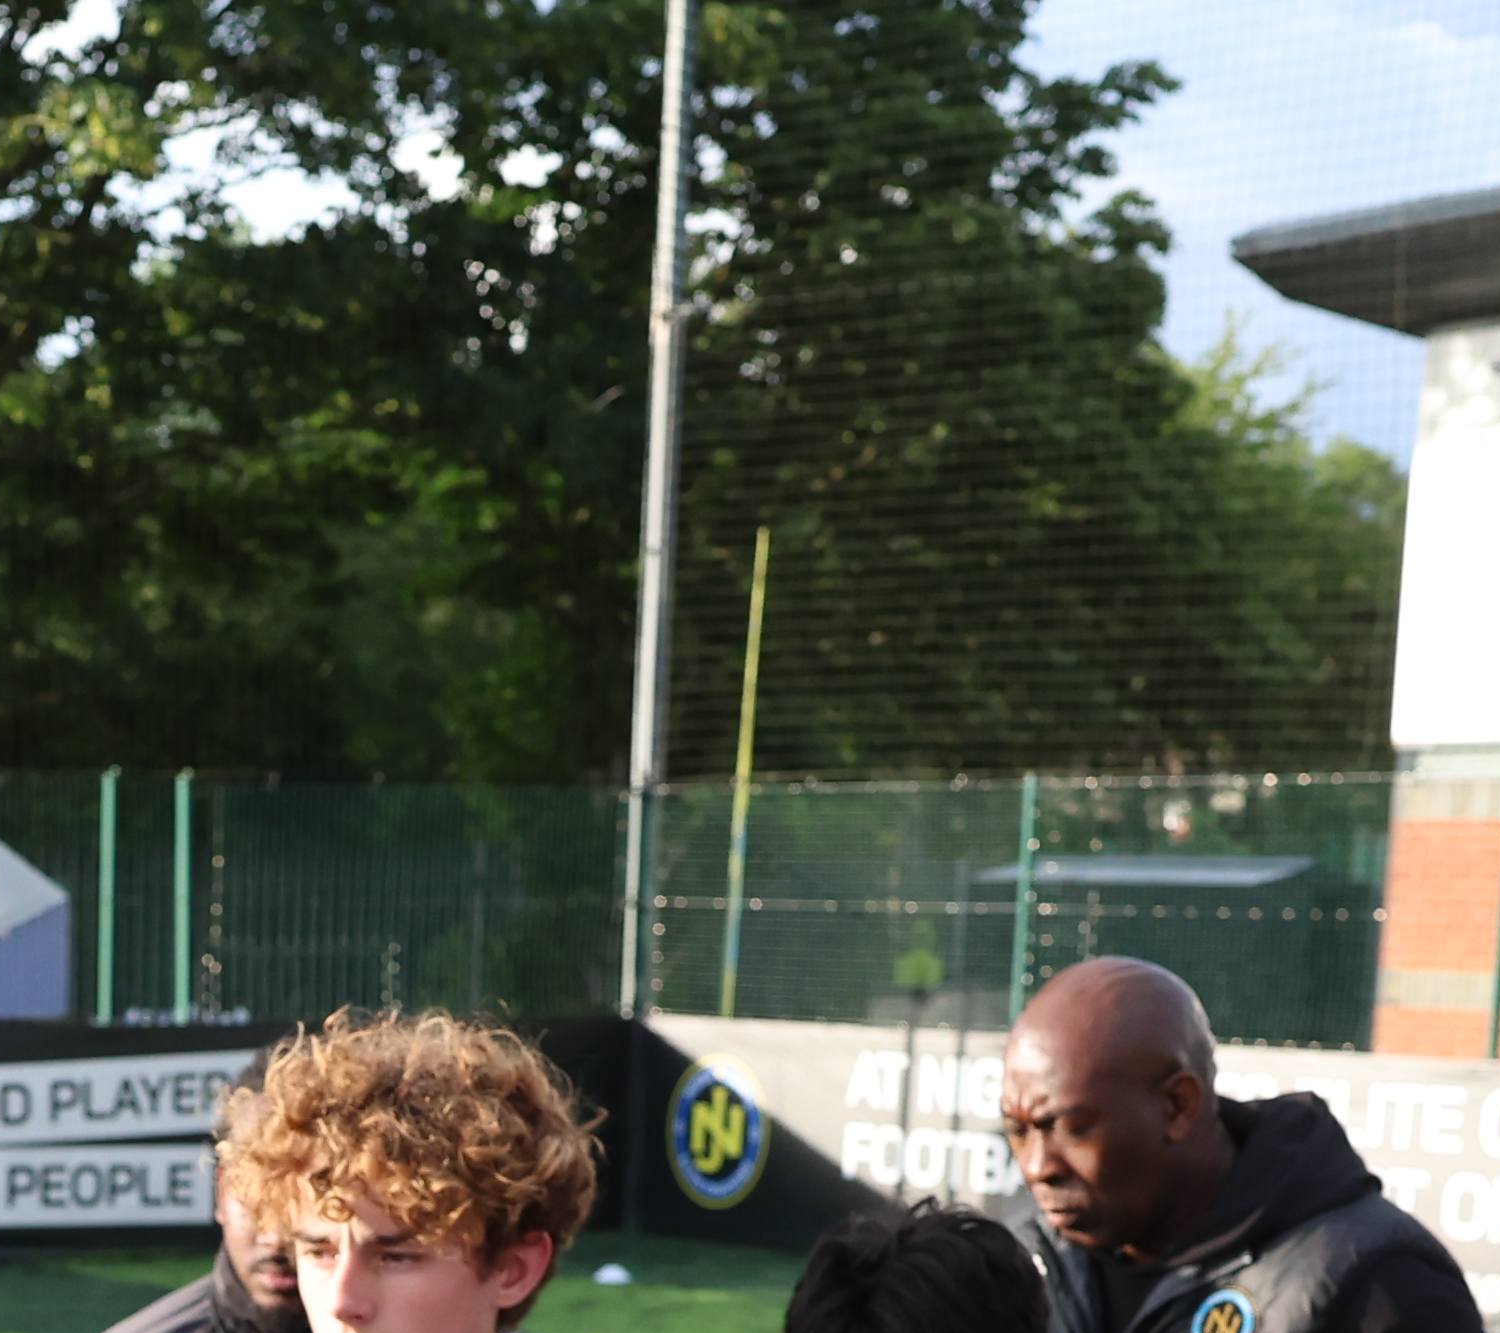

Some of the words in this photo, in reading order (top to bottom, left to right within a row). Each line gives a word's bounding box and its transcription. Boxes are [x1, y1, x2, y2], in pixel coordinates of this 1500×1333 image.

[844, 1049, 909, 1111] AT
[917, 1053, 1005, 1120] NIG
[6, 1160, 195, 1208] PEOPLE
